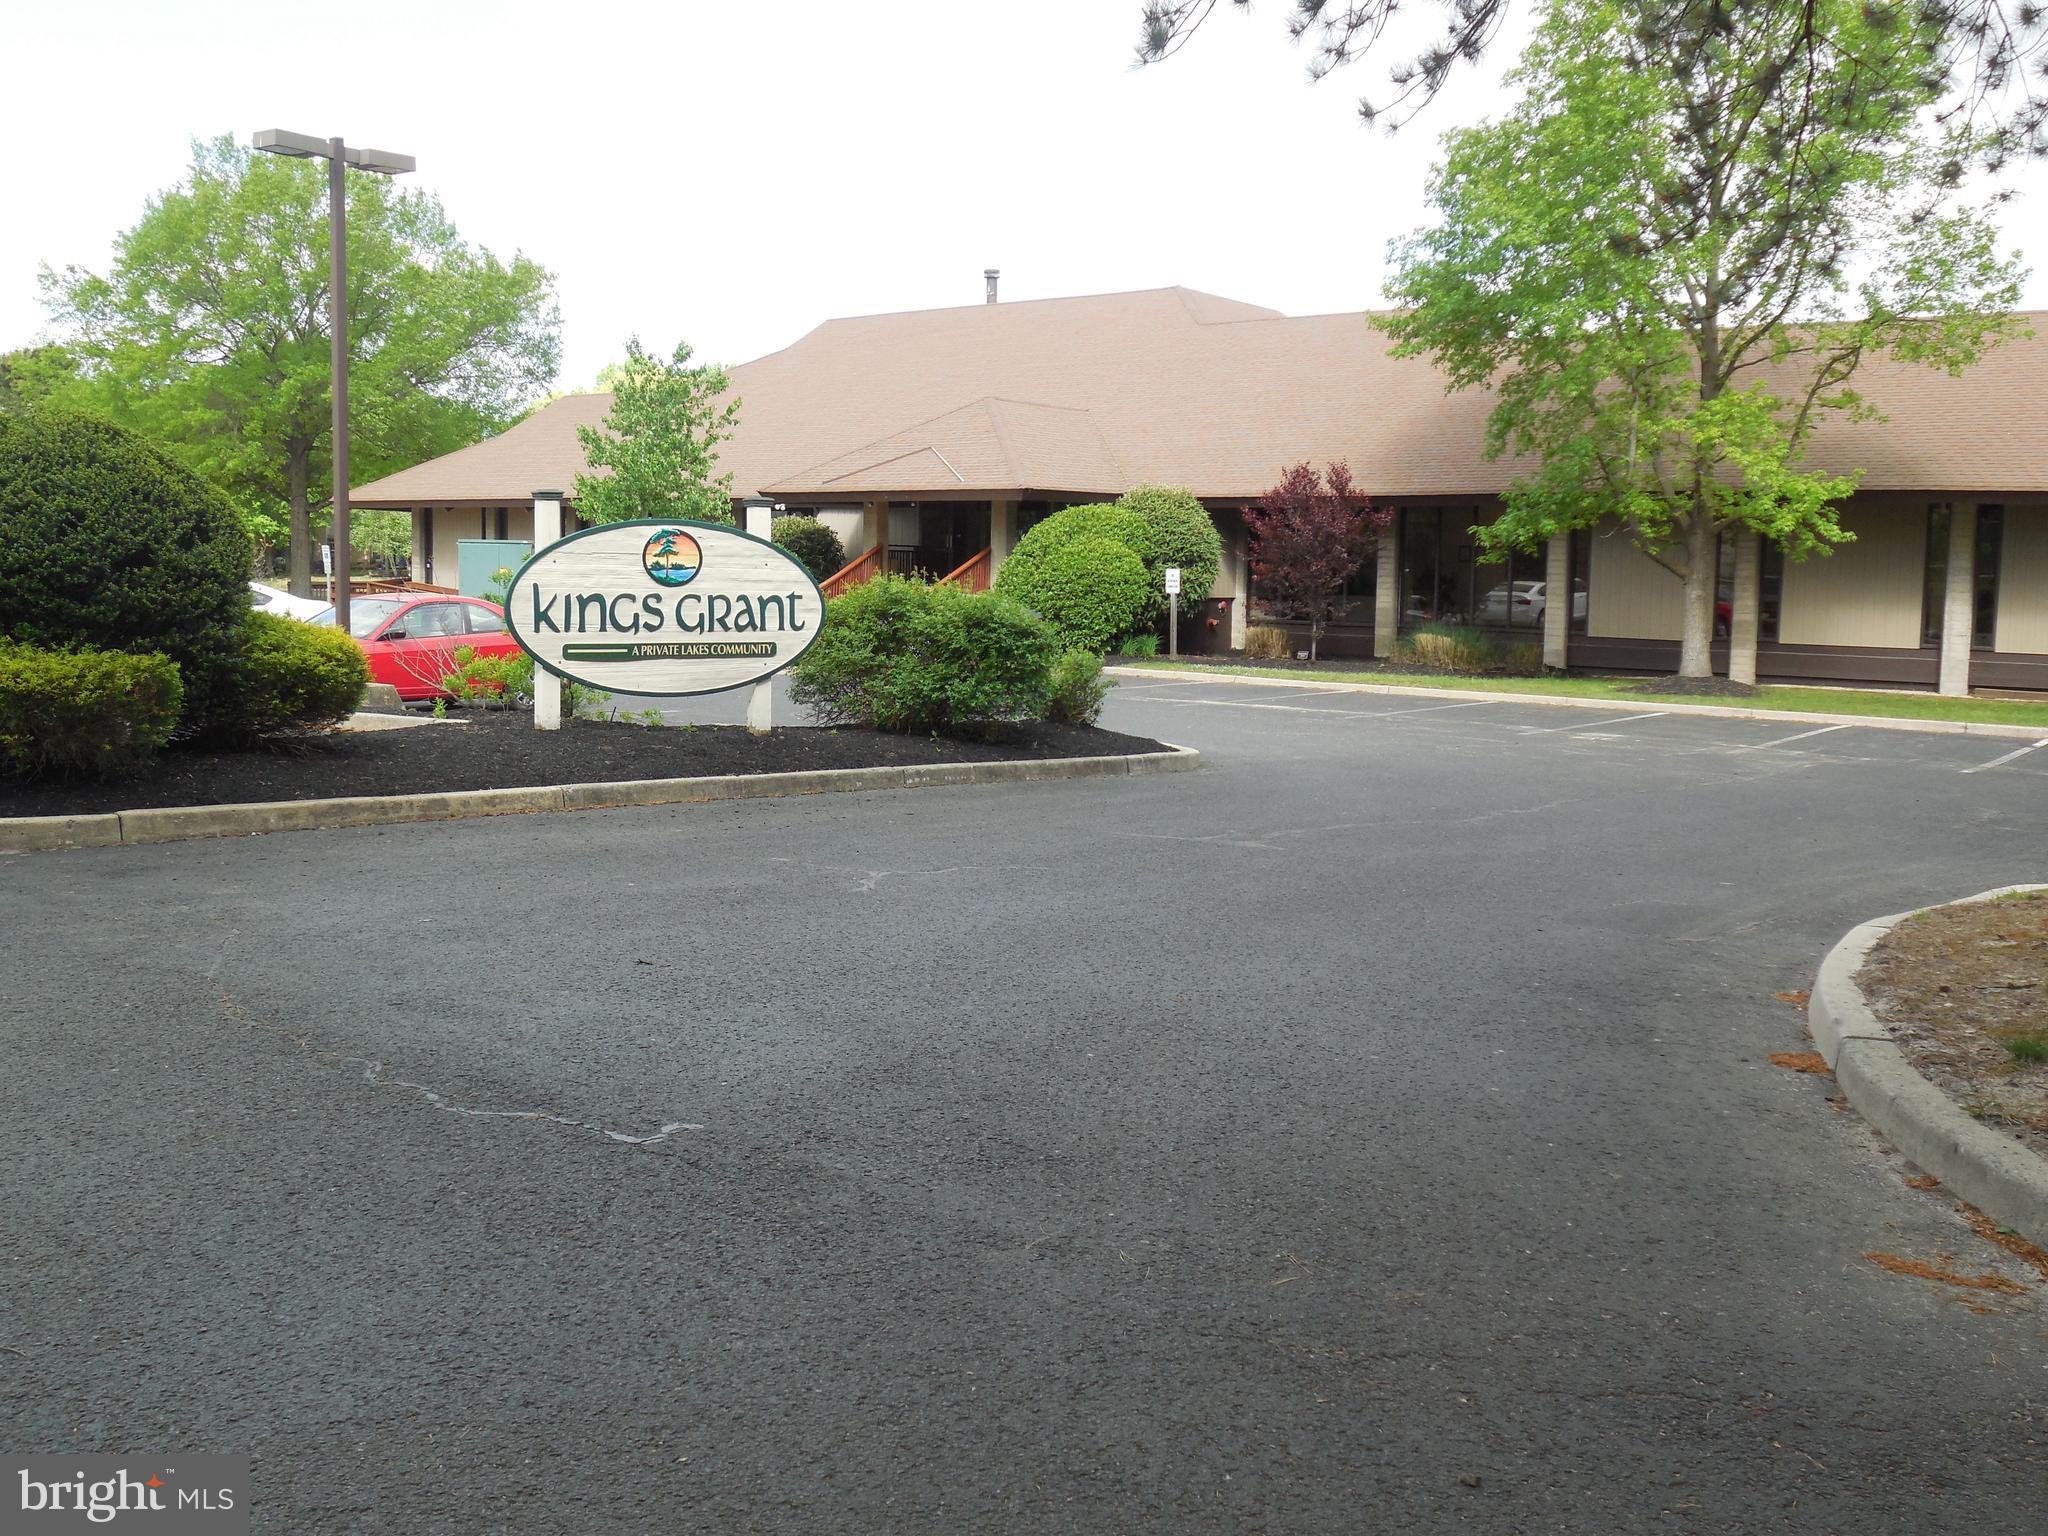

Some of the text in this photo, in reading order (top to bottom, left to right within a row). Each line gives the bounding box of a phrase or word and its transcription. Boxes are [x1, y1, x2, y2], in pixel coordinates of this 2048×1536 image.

[631, 644, 773, 656] A PRIVATE LAKES COMMUNITY
